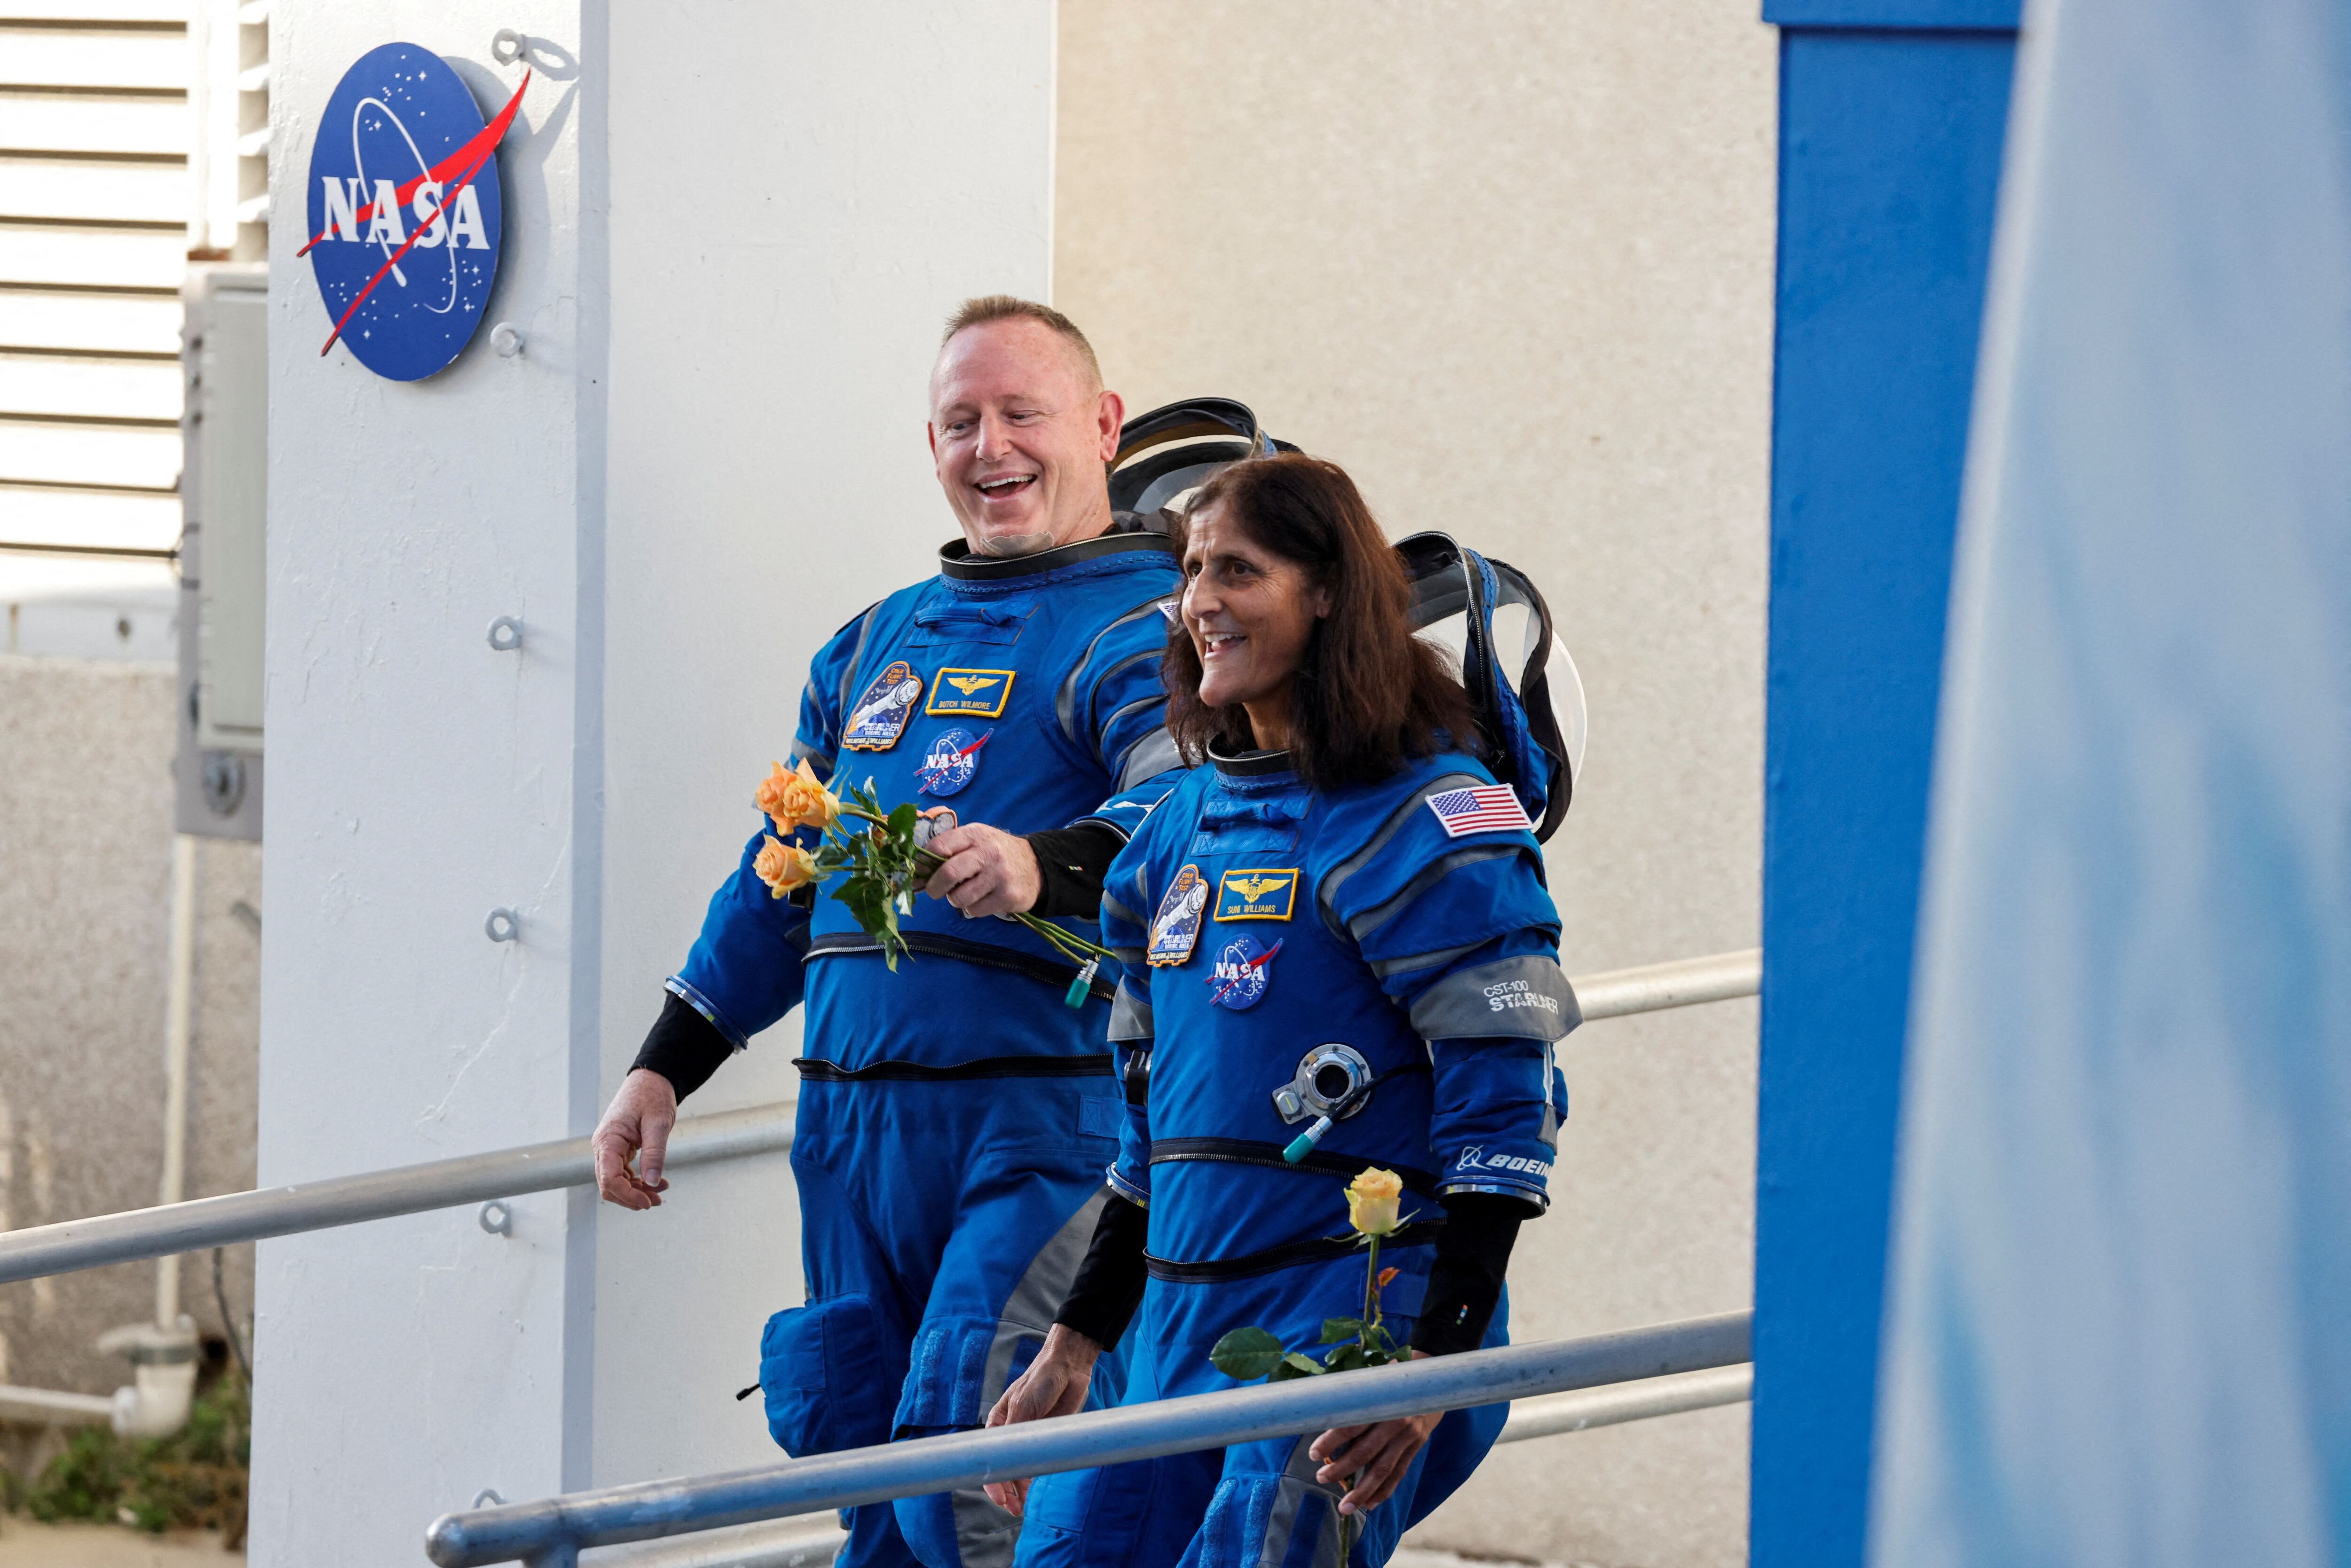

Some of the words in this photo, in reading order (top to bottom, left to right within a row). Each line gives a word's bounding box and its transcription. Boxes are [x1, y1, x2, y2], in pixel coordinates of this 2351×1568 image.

[321, 176, 490, 250] NASA
[961, 700, 991, 710] WILMORE
[924, 753, 974, 769] NASA
[1227, 905, 1241, 914] SUNI
[1244, 904, 1276, 914] WILLIAMS
[1214, 962, 1265, 981] NASA
[1483, 980, 1529, 997] CST-100
[1489, 992, 1559, 1015] STARLINER
[1485, 1153, 1552, 1177] BOEIN
